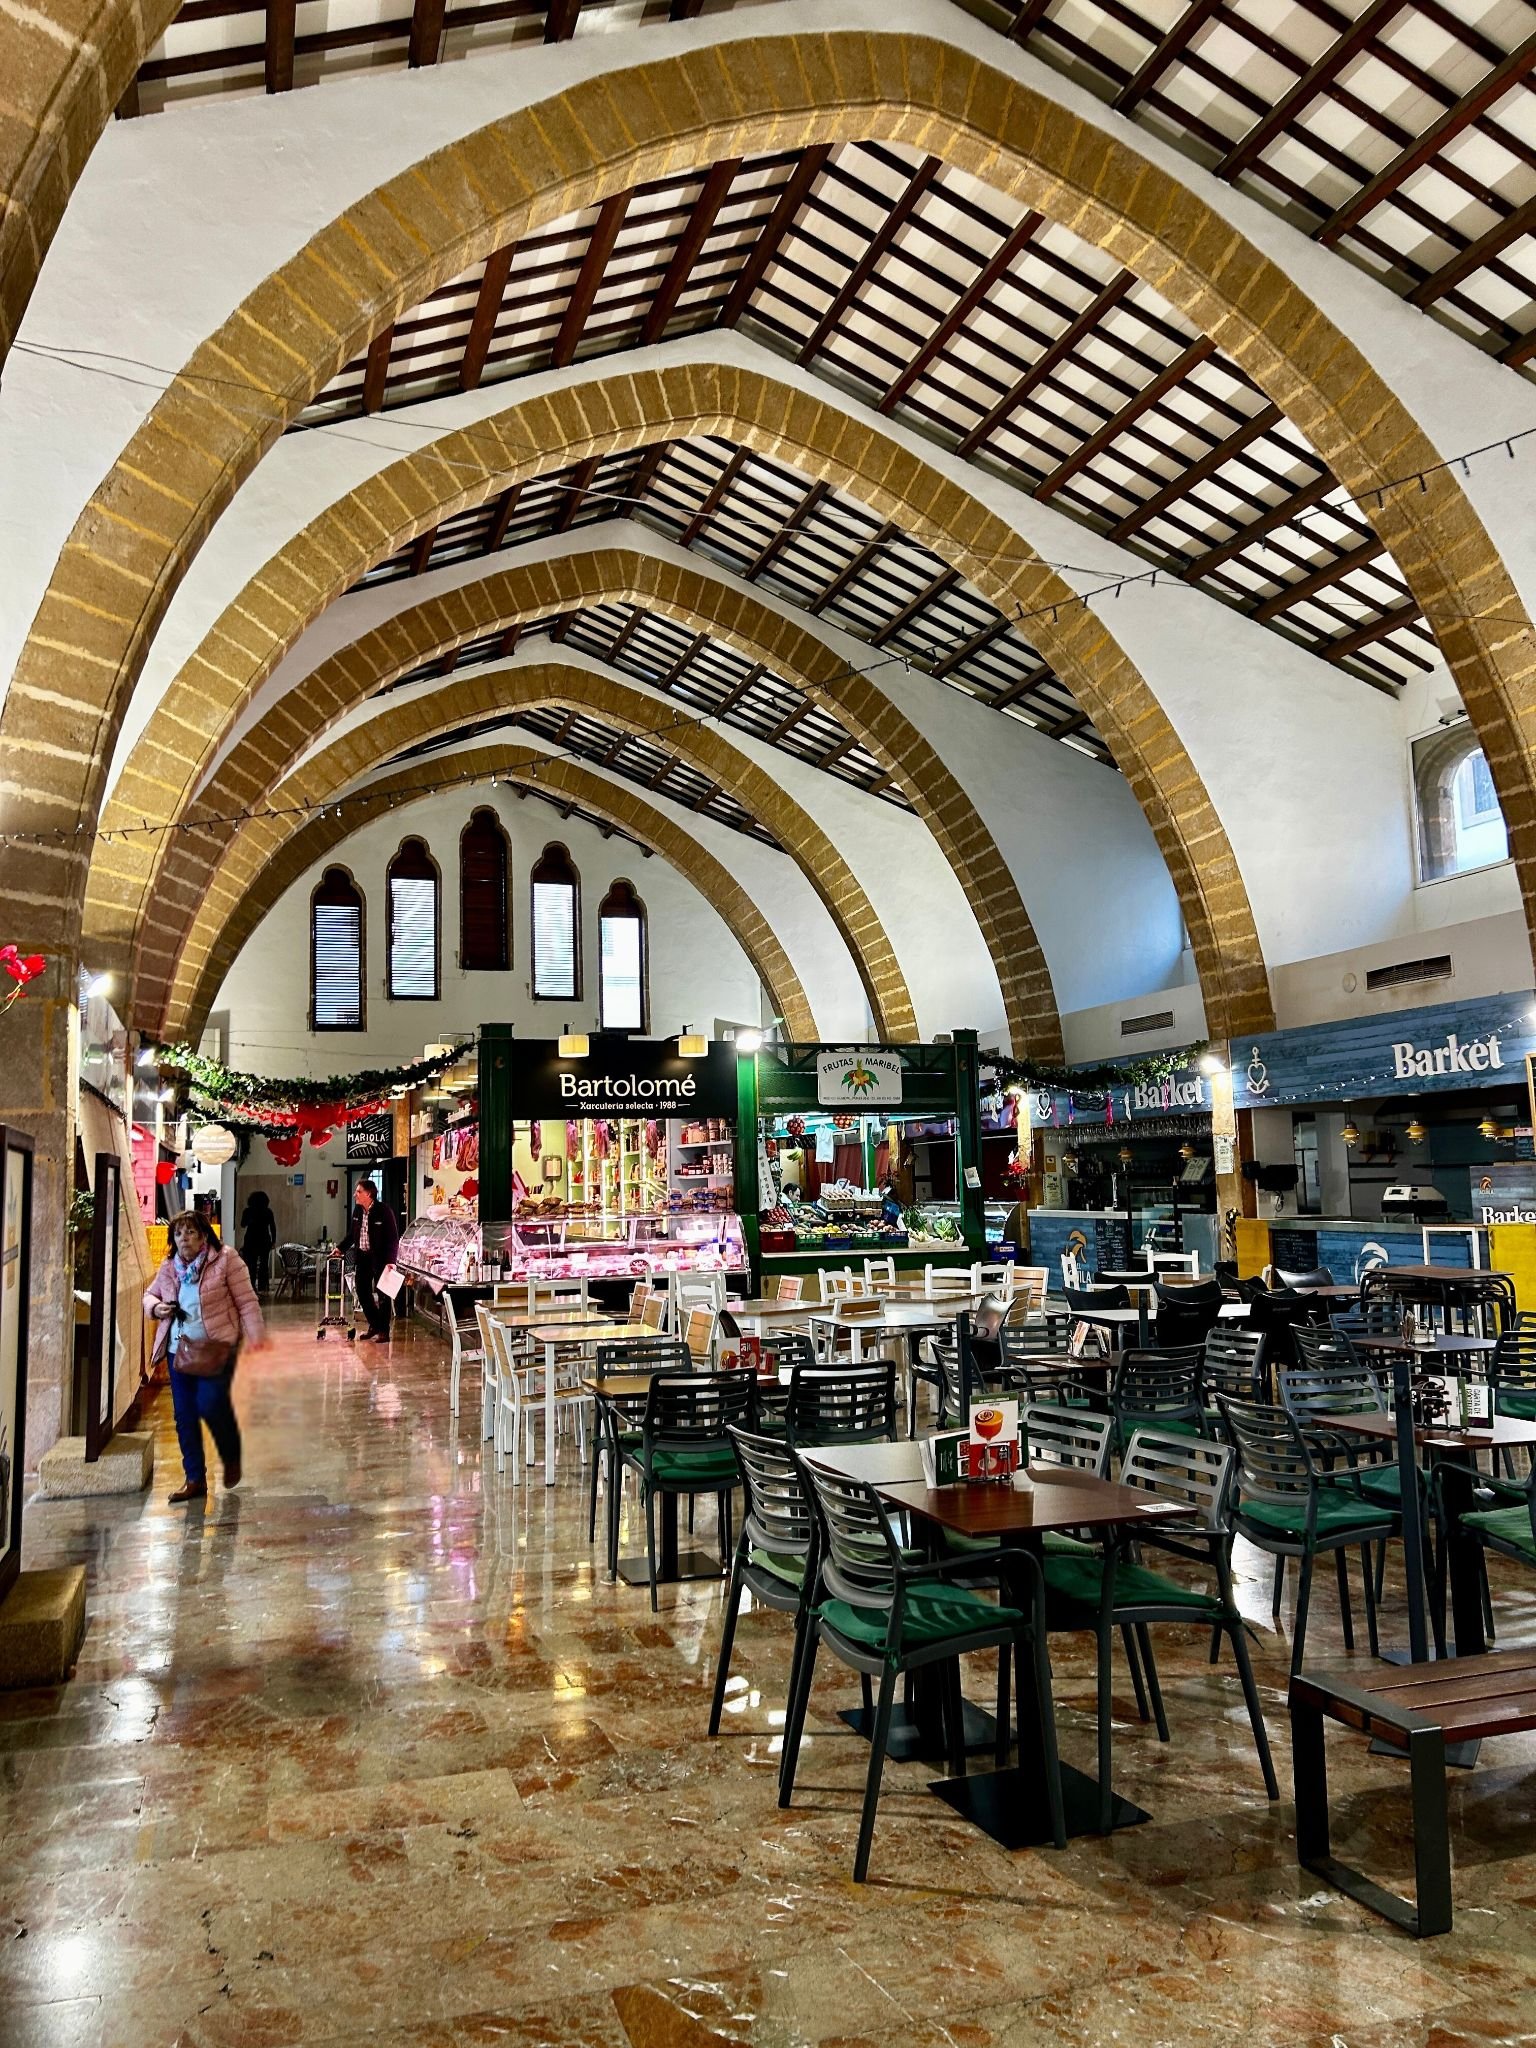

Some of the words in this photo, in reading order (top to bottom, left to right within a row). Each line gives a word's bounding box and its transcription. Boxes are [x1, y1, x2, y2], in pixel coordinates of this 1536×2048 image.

[1392, 1034, 1504, 1079] Barket
[822, 1057, 854, 1074] FRUTAS
[865, 1057, 900, 1075] MARIBEL
[559, 1073, 696, 1097] Bartolomé
[625, 1101, 653, 1110] selecta
[660, 1101, 676, 1109] 1988
[350, 1120, 362, 1129] LA
[347, 1132, 386, 1142] MARIOLA
[1481, 1206, 1536, 1225] Barke
